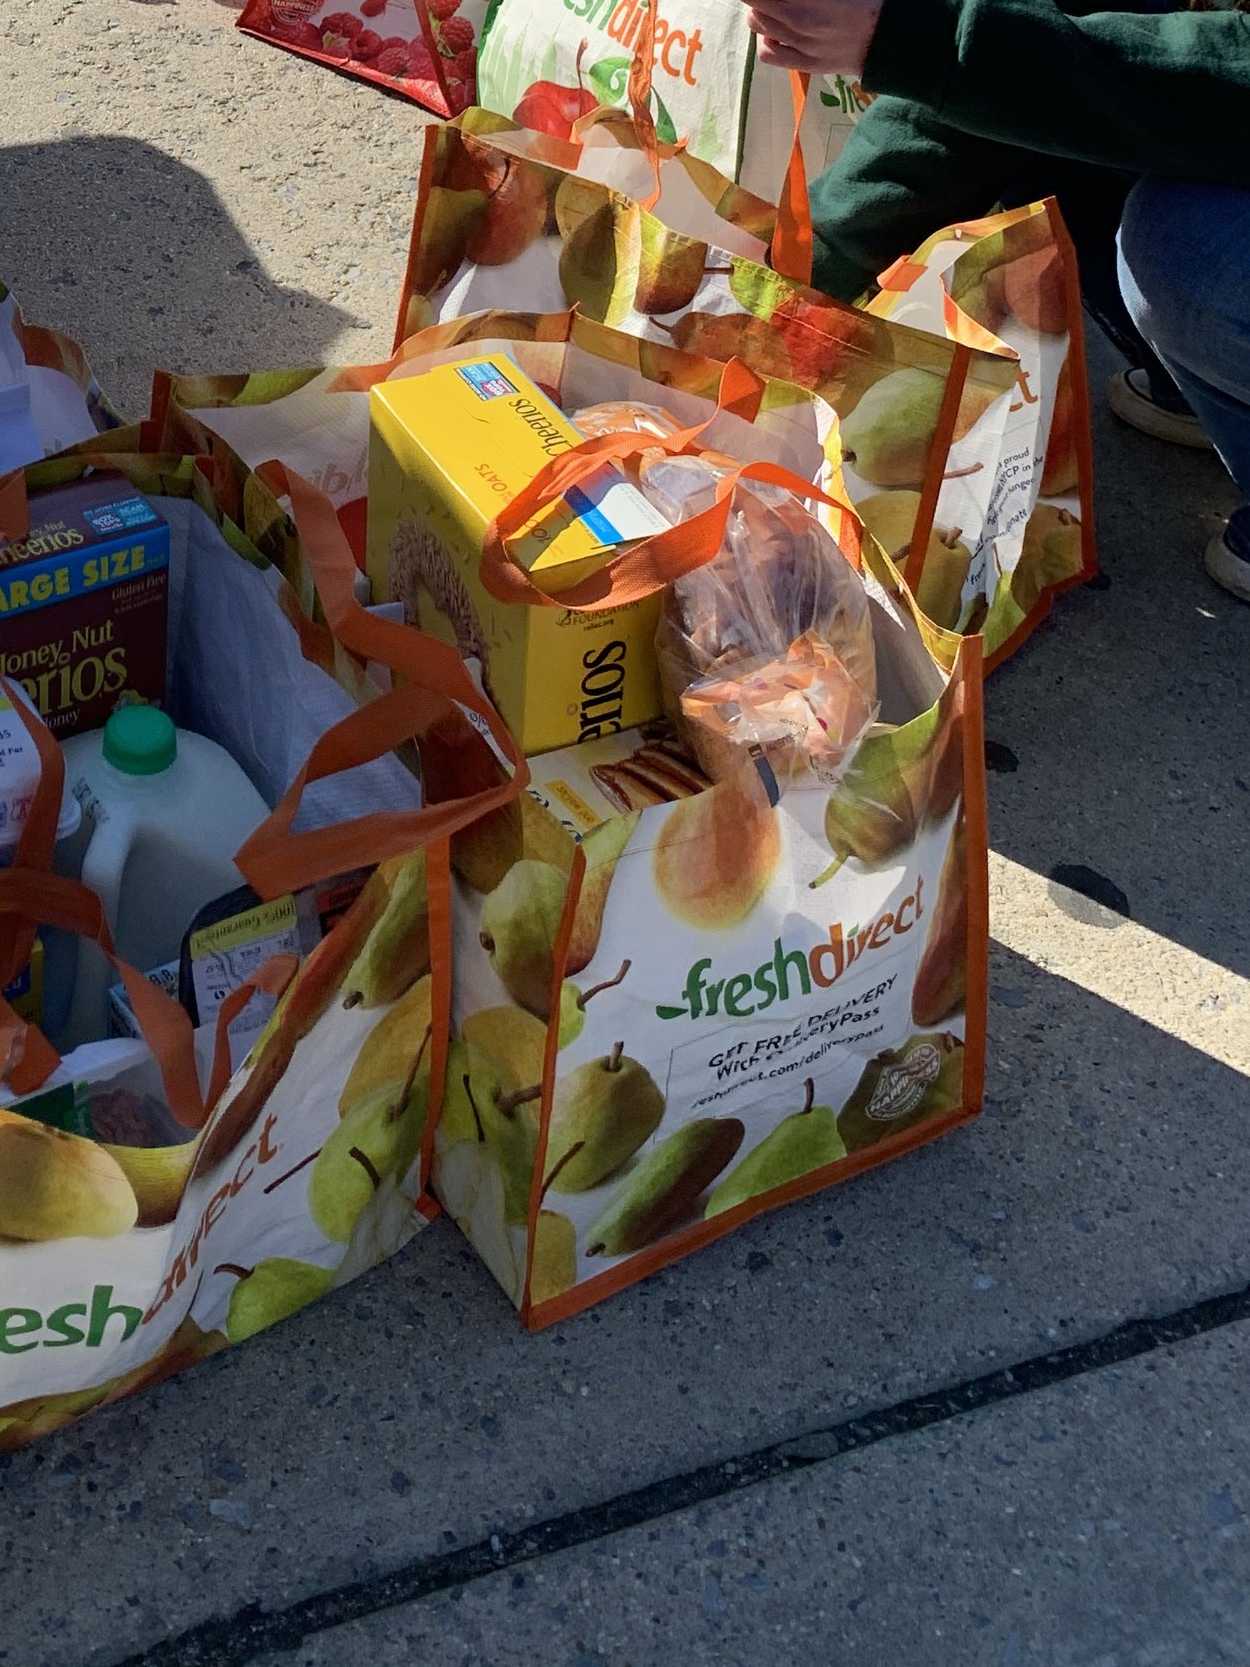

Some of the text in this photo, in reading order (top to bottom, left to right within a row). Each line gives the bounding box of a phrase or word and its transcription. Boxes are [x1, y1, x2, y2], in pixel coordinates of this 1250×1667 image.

[1003, 447, 1030, 468] proud
[1022, 464, 1032, 473] in
[473, 462, 508, 495] OATS
[83, 545, 146, 586] SIZE
[111, 573, 167, 601] Gluten Free
[72, 619, 114, 654] Nut
[21, 647, 128, 715] erios
[577, 641, 627, 744] erios
[680, 875, 924, 1020] freshdirect
[708, 1040, 748, 1068] GET
[807, 973, 898, 1028] DELIVERY
